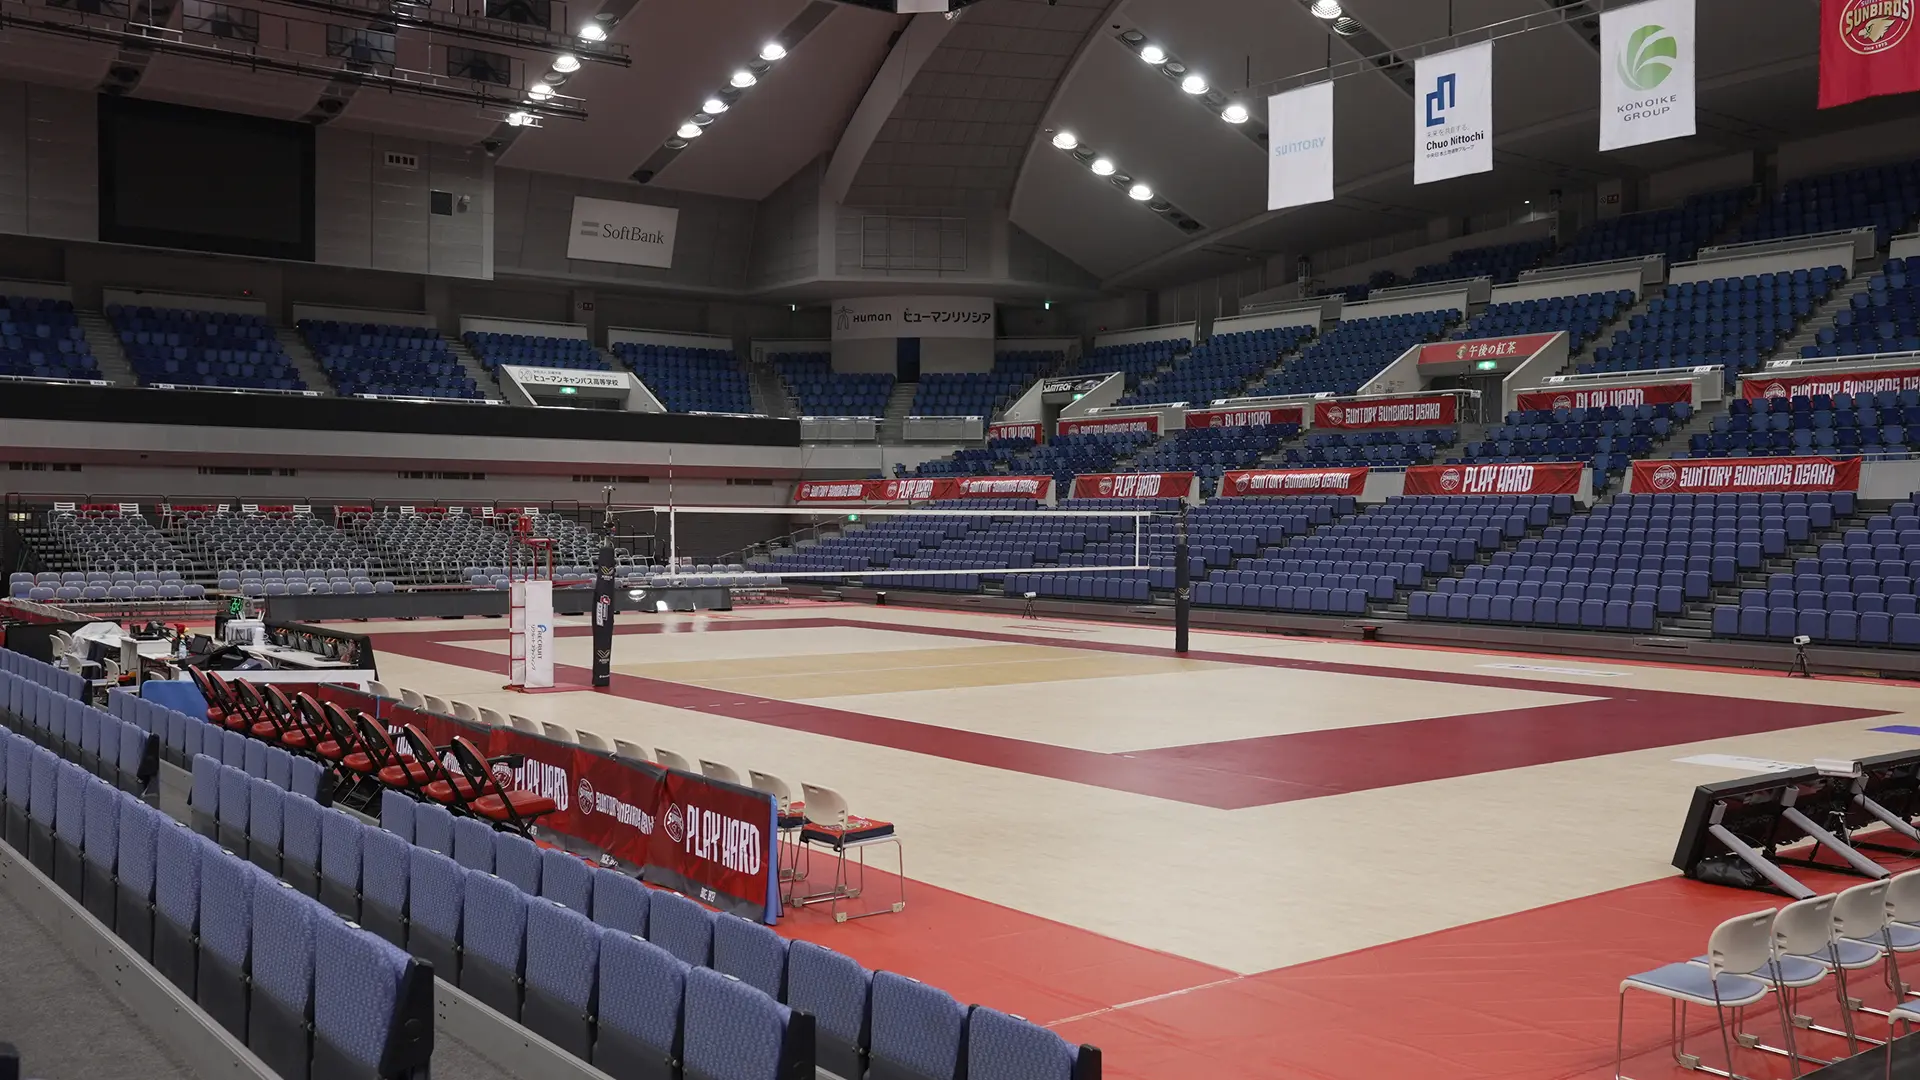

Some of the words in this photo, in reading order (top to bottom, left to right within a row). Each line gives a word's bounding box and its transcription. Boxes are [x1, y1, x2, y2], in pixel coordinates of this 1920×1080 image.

[1845, 0, 1909, 35] SUNBIRDS
[1617, 94, 1677, 113] KONOIKE
[1623, 106, 1670, 122] GROUP
[1426, 140, 1449, 151] Chuo
[1450, 130, 1484, 146] Nittochi
[602, 223, 665, 245] SoftBank
[903, 307, 991, 324] ヒューマンリソシア
[1468, 341, 1517, 358] 午後の紅茶
[533, 374, 619, 387] ヒューマンキャンパス高等学校
[1345, 406, 1377, 424] SUNTORY
[1378, 404, 1414, 422] SUNBIRDS
[1415, 402, 1441, 420] OSAKA
[1112, 475, 1137, 497] PLAY
[1135, 474, 1161, 497] HARD
[1250, 474, 1285, 489] SUNTORY
[1284, 473, 1323, 489] SUNBIRDS
[1321, 472, 1351, 489] OSAKA
[1462, 466, 1500, 493] PLAY
[1496, 465, 1534, 492] HARD
[1679, 466, 1733, 487] SUNTORY
[1733, 464, 1793, 486] SUNBIRDS
[1793, 463, 1836, 485] OSAKA
[897, 480, 916, 499] PLAY
[685, 804, 722, 863] PLAY
[721, 815, 761, 876] HARD
